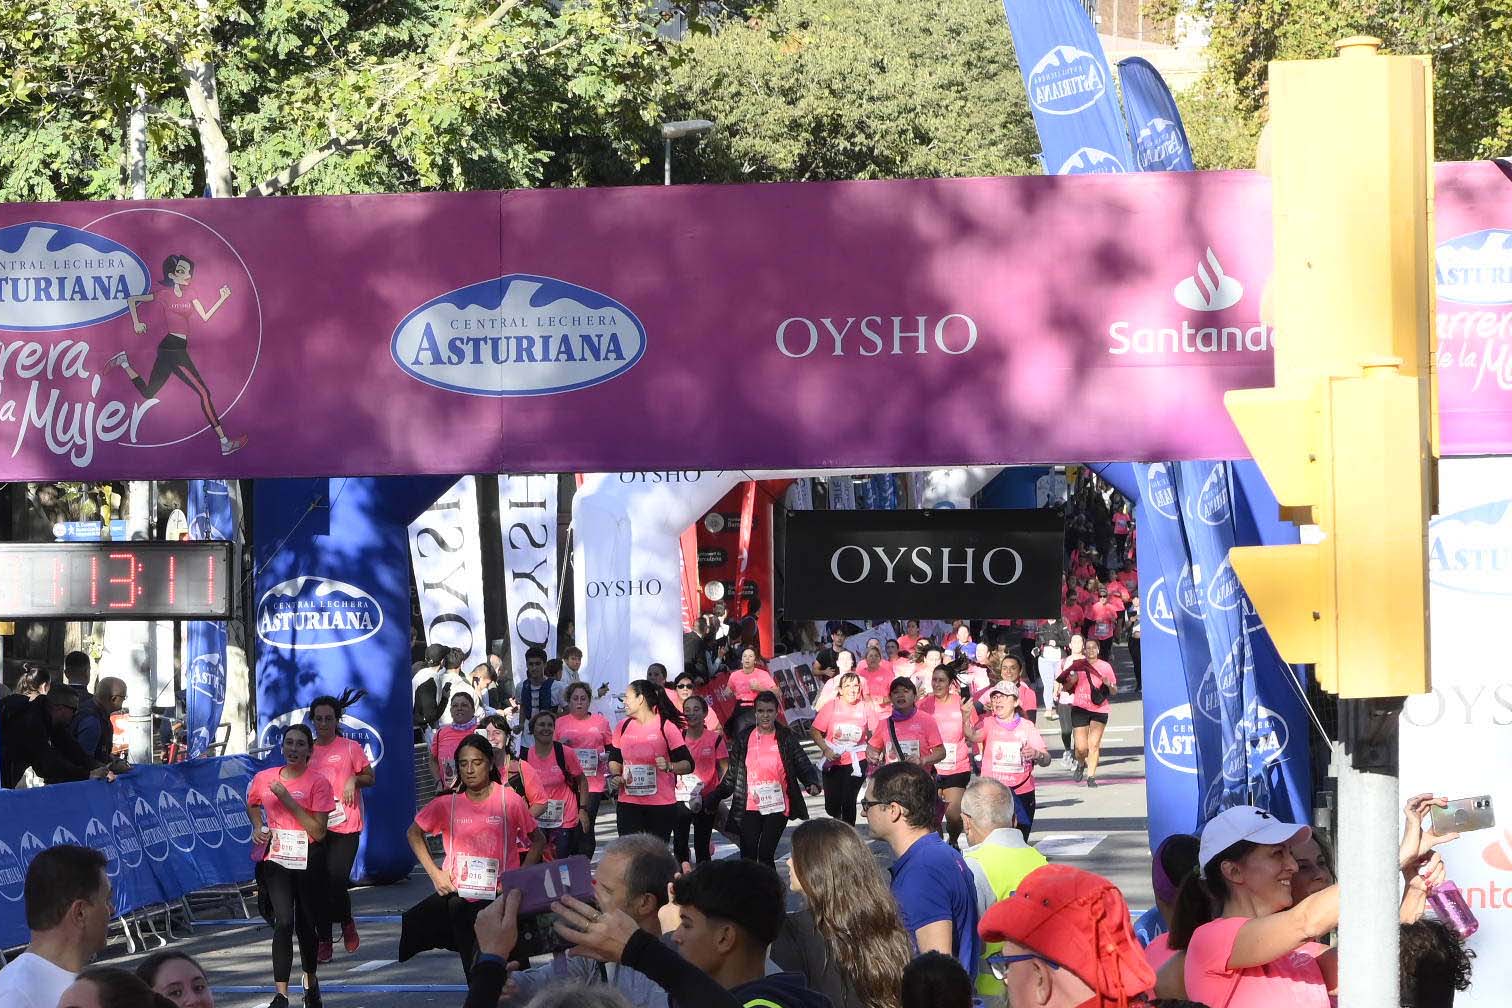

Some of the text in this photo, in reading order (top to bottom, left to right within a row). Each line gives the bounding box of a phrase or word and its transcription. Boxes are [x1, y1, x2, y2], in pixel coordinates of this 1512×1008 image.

[54, 259, 125, 270] LECHERA
[450, 314, 618, 330] CENTRAL LECHERA
[775, 313, 979, 359] OYSHO
[1108, 320, 1275, 355] Santand
[411, 321, 627, 367] ASTURIANA
[11, 374, 161, 468] Mujer
[830, 544, 1024, 586] OYSHO
[586, 576, 663, 600] OYSHO
[260, 606, 375, 634] ASTURIANA
